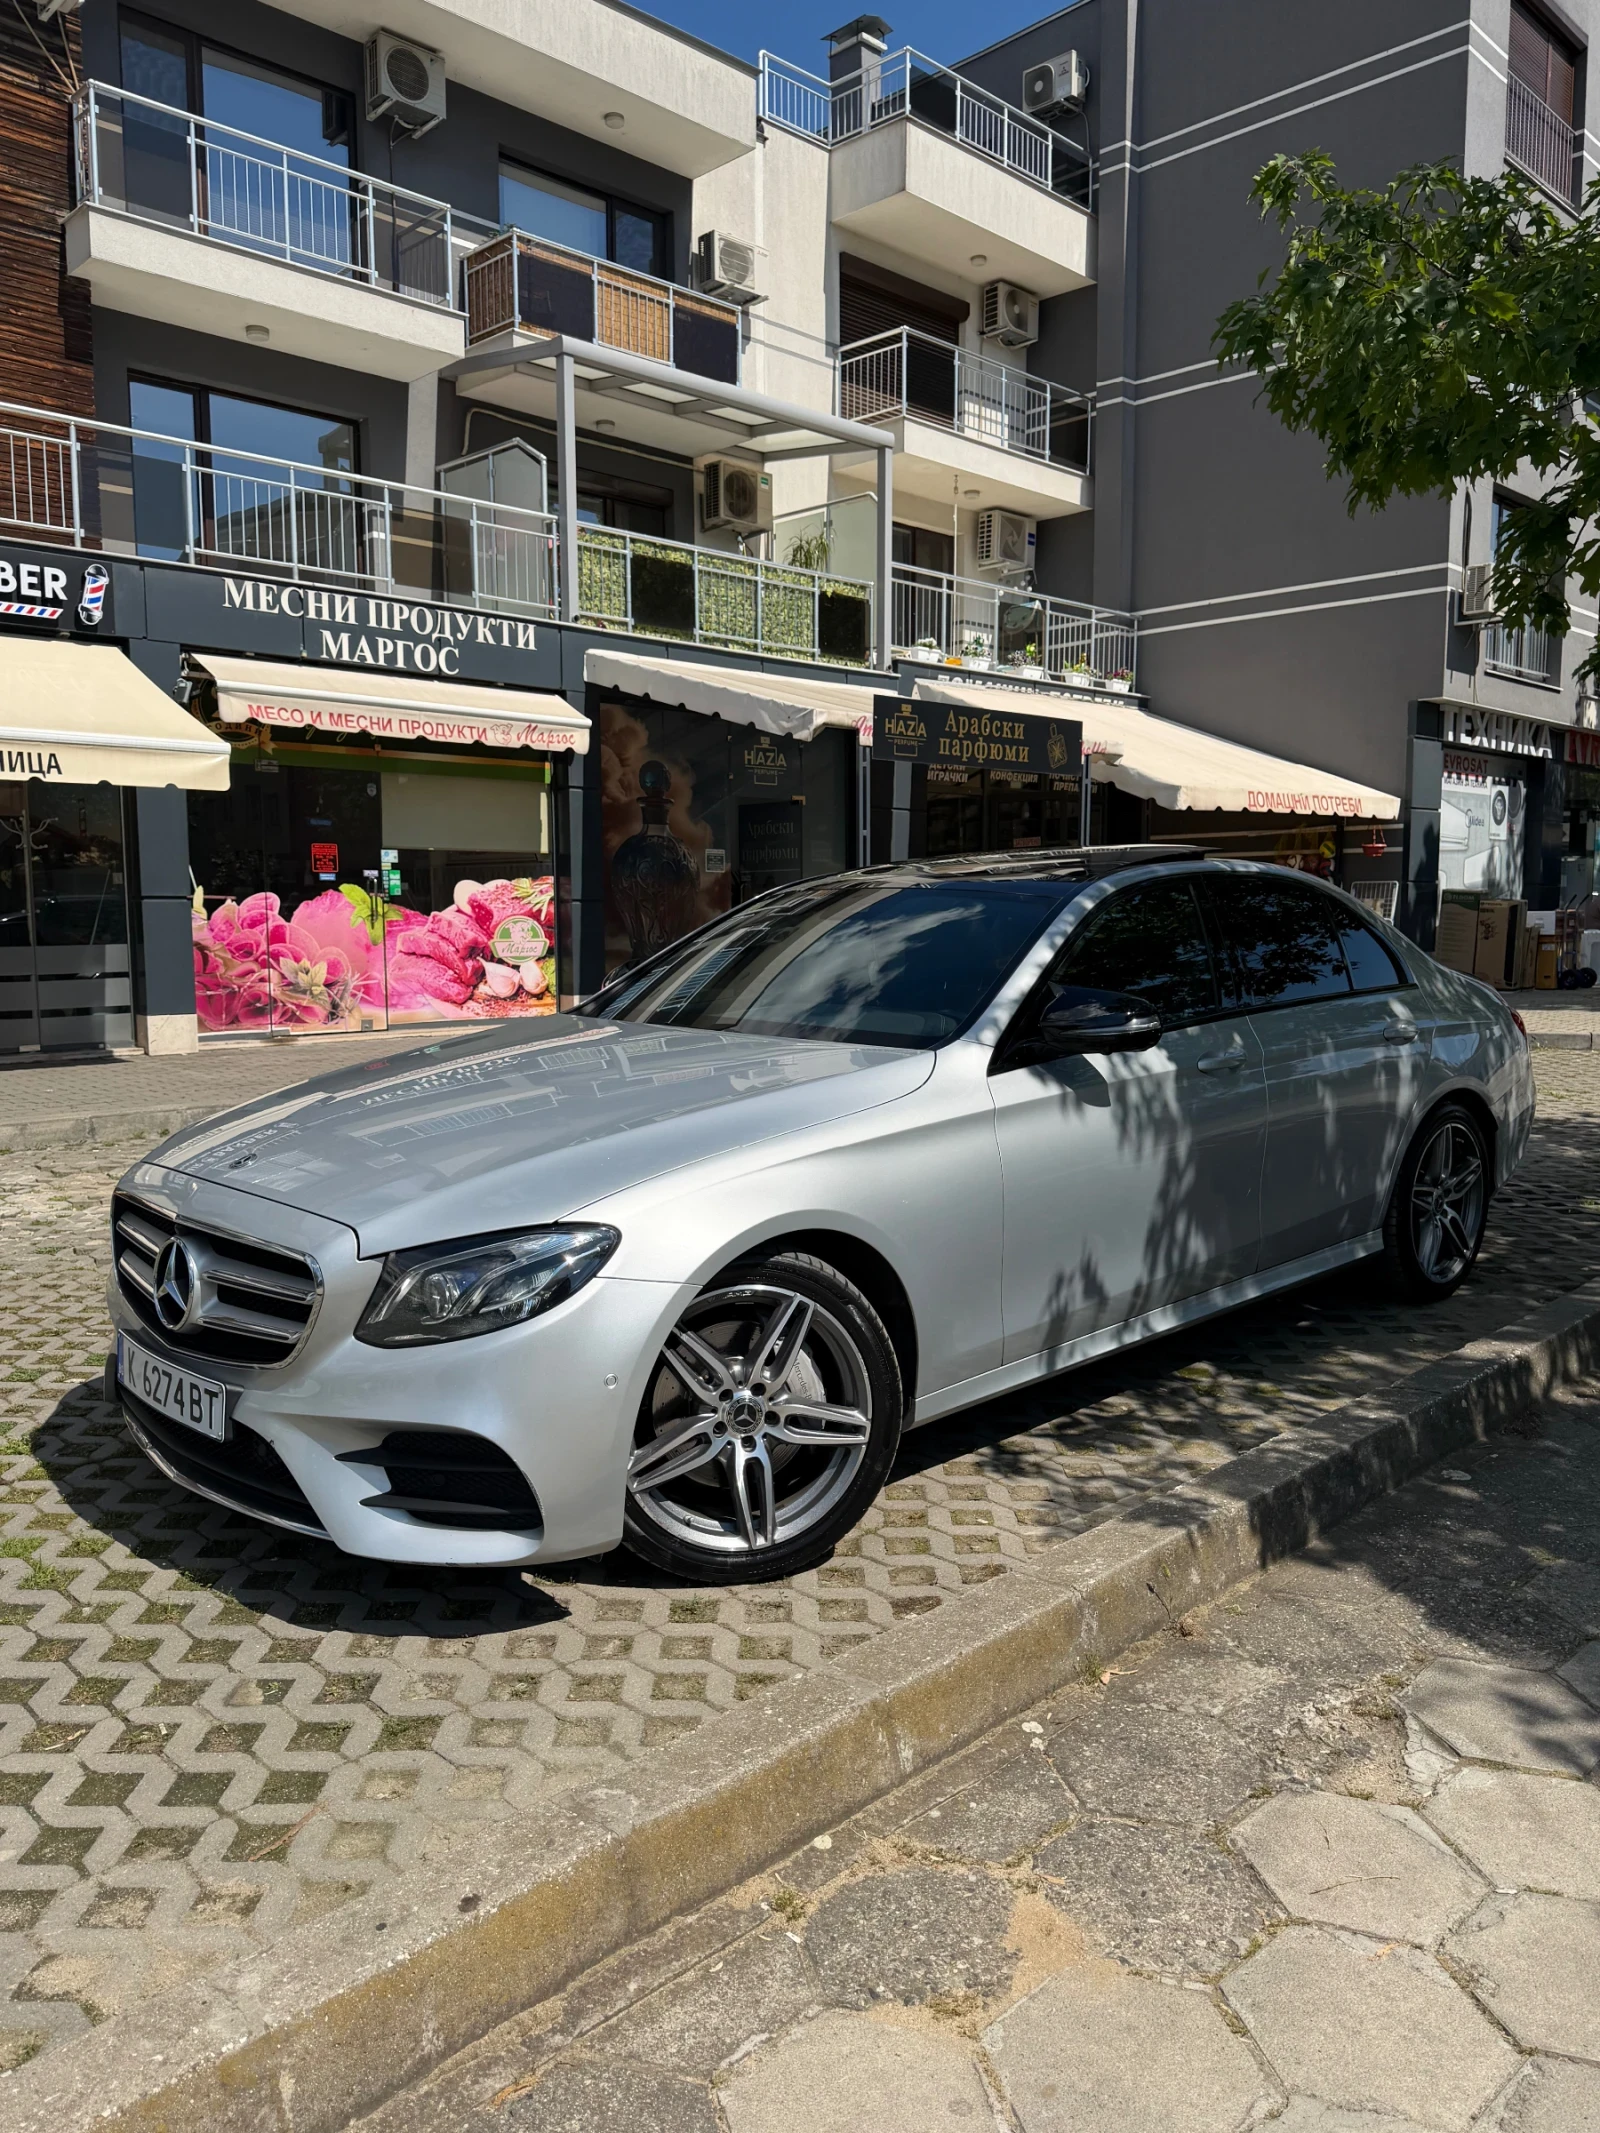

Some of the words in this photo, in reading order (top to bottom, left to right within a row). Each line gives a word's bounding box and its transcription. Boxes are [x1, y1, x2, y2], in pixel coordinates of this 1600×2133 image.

[0, 560, 68, 601] BER
[222, 577, 359, 625] МЕСНИ
[366, 598, 538, 651] ПРОДУКТИ
[319, 629, 460, 675] МАРГОС
[247, 704, 304, 724] МЕСО
[310, 710, 324, 726] И
[328, 712, 393, 733] МЕСНИ
[398, 718, 489, 742] ПРОДУКТИ
[516, 723, 577, 750] Маргос
[885, 718, 927, 738] HAZA
[944, 709, 1025, 740] Арабски
[1440, 704, 1553, 759] ТЕХНИКА
[894, 738, 918, 746] PERFUME
[938, 737, 1030, 764] парфюми
[0, 750, 63, 779] ИЦА
[744, 750, 787, 767] HAZA
[1443, 753, 1489, 774] EVROSAT
[927, 770, 969, 783] ИГРАЧКИ
[990, 771, 1039, 784] КОНФЕКЦИЯ
[1247, 790, 1311, 811] ДОМАШНИ
[1312, 795, 1363, 813] ПОТРЕБИ
[747, 820, 794, 838] Арабски
[741, 844, 799, 863] парфюми
[502, 943, 538, 955] Маргос
